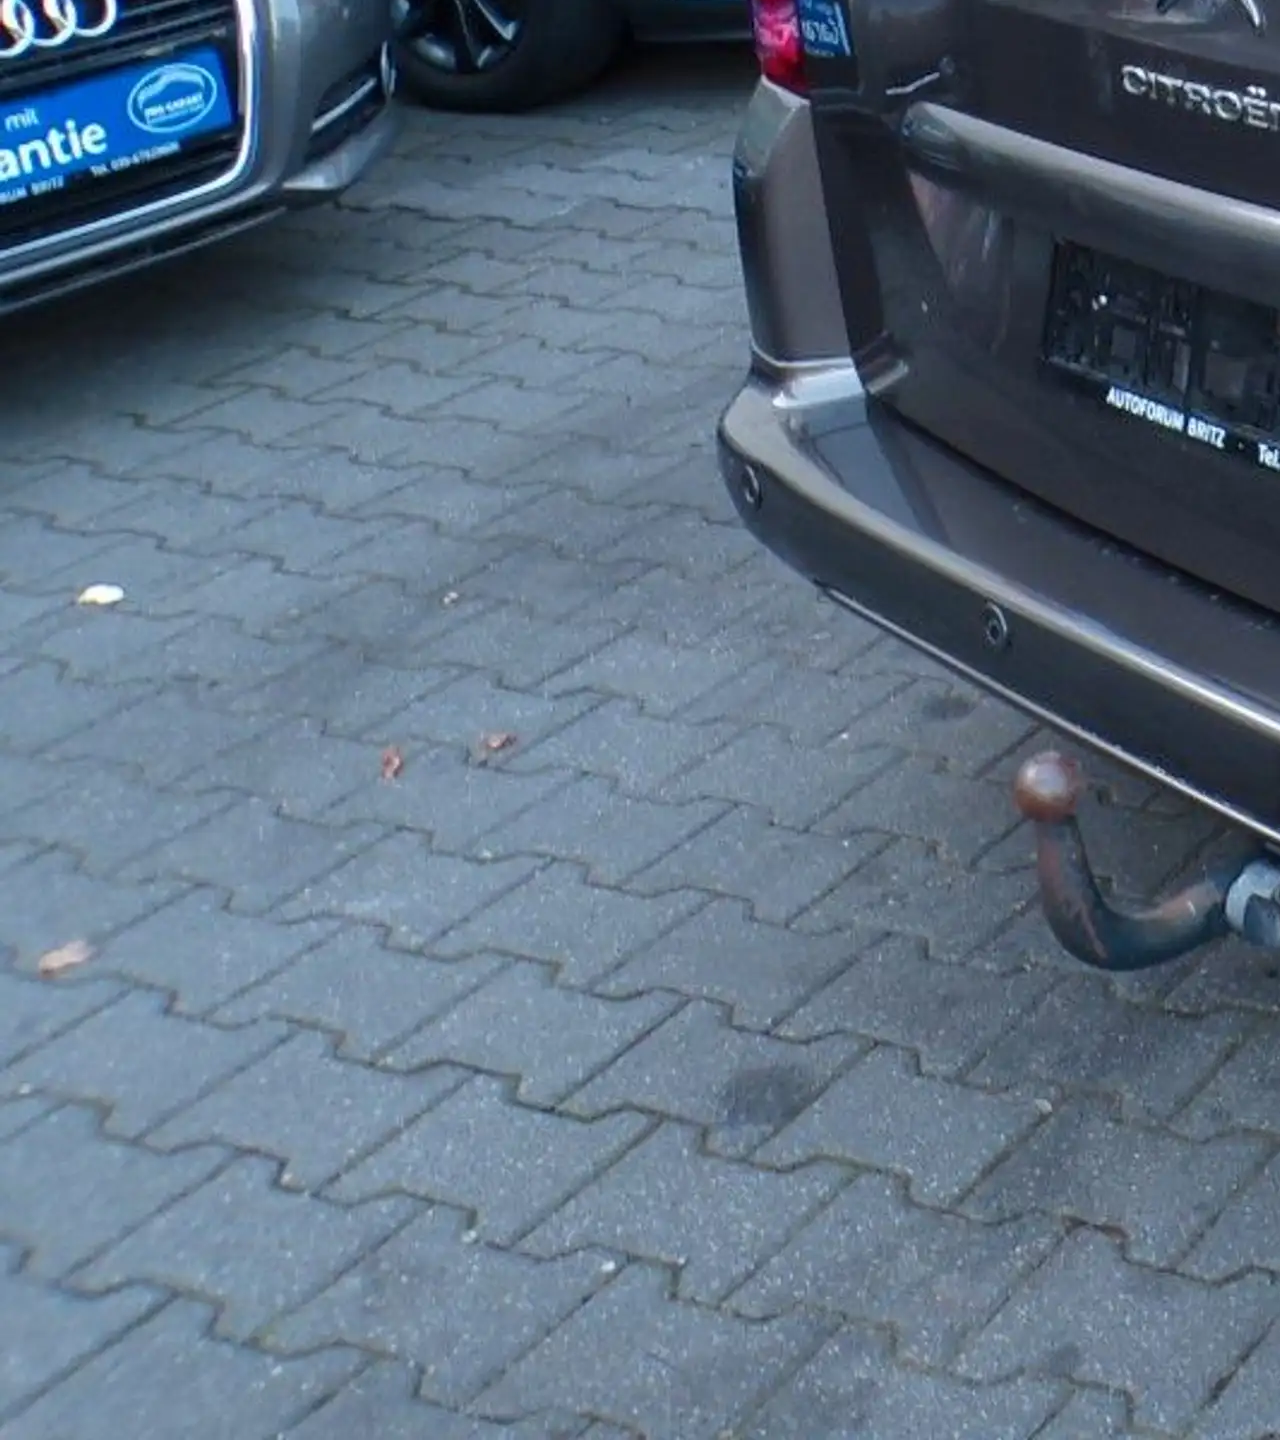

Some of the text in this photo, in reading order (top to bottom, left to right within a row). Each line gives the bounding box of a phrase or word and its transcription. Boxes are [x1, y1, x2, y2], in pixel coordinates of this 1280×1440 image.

[4, 107, 41, 133] mit
[1105, 386, 1185, 432] AUTOFORUM
[1186, 417, 1227, 450] BRITZ
[1257, 443, 1280, 469] Tel.
